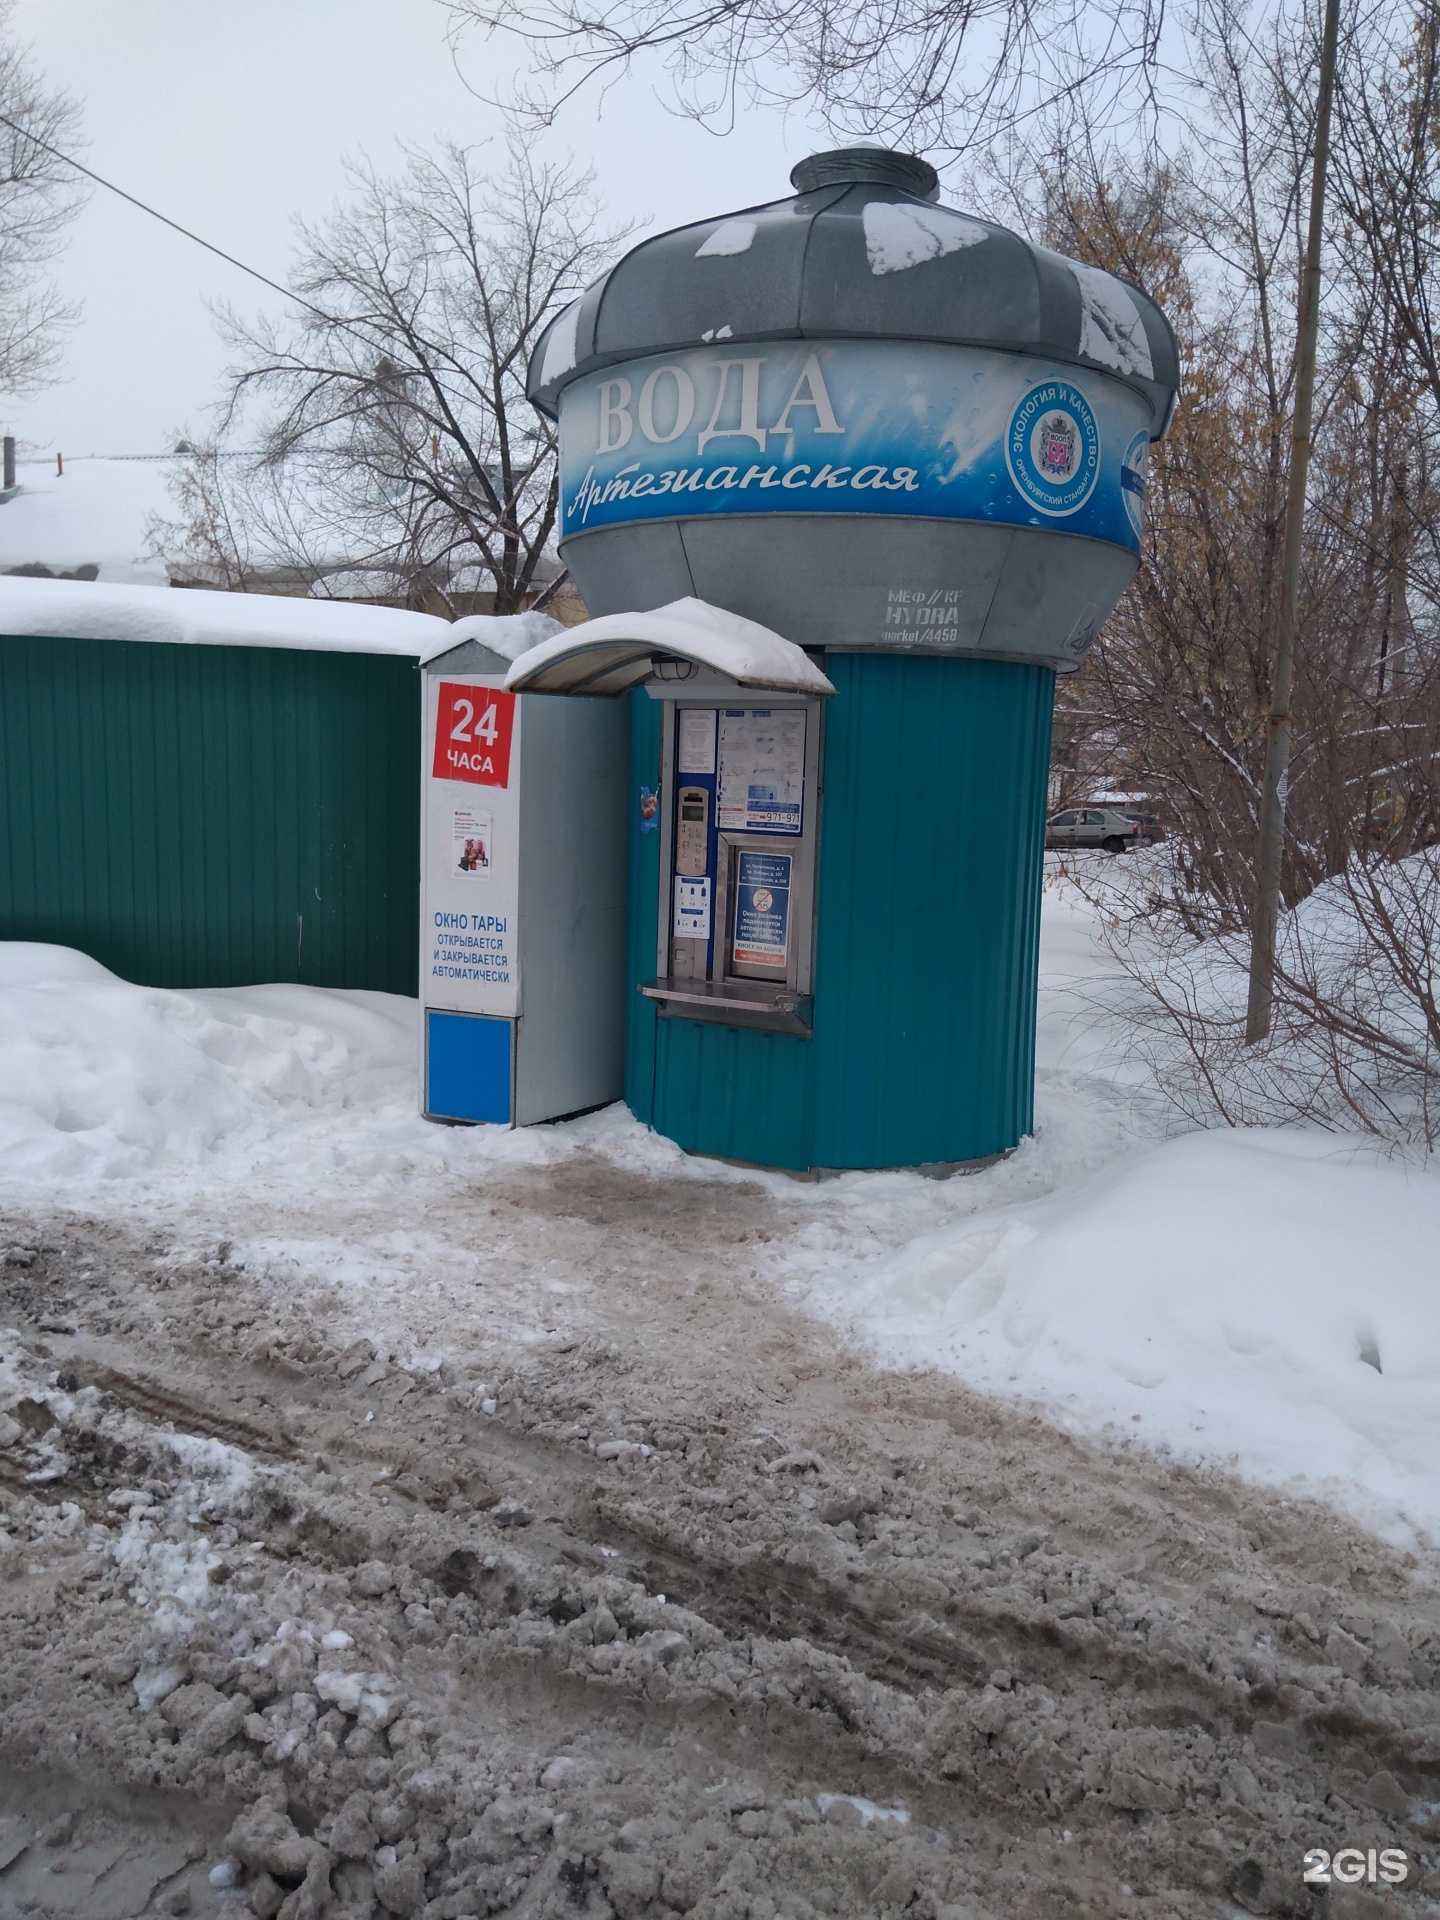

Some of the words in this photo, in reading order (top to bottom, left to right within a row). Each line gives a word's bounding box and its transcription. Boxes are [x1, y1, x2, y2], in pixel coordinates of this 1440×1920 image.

[598, 353, 846, 455] ВОДА
[1013, 387, 1057, 453] ЭКОЛОГИЯ
[1059, 387, 1067, 401] И
[1069, 394, 1097, 468] КАЧЕСТВО
[567, 462, 919, 524] Артезианская
[1063, 471, 1091, 504] СТАНДАРТ
[886, 606, 959, 625] HYDRA
[450, 698, 499, 747] 24
[447, 749, 494, 774] ЧАСА
[434, 911, 468, 930] ОКНО
[471, 914, 507, 933] ТАРЫ
[437, 933, 503, 951] ОТКРЫВАЕТСЯ
[433, 949, 440, 961] И
[442, 950, 508, 967] ЗАКРЫВАЕТСЯ
[432, 965, 511, 983] АВТОМАТИЧЕСКИ
